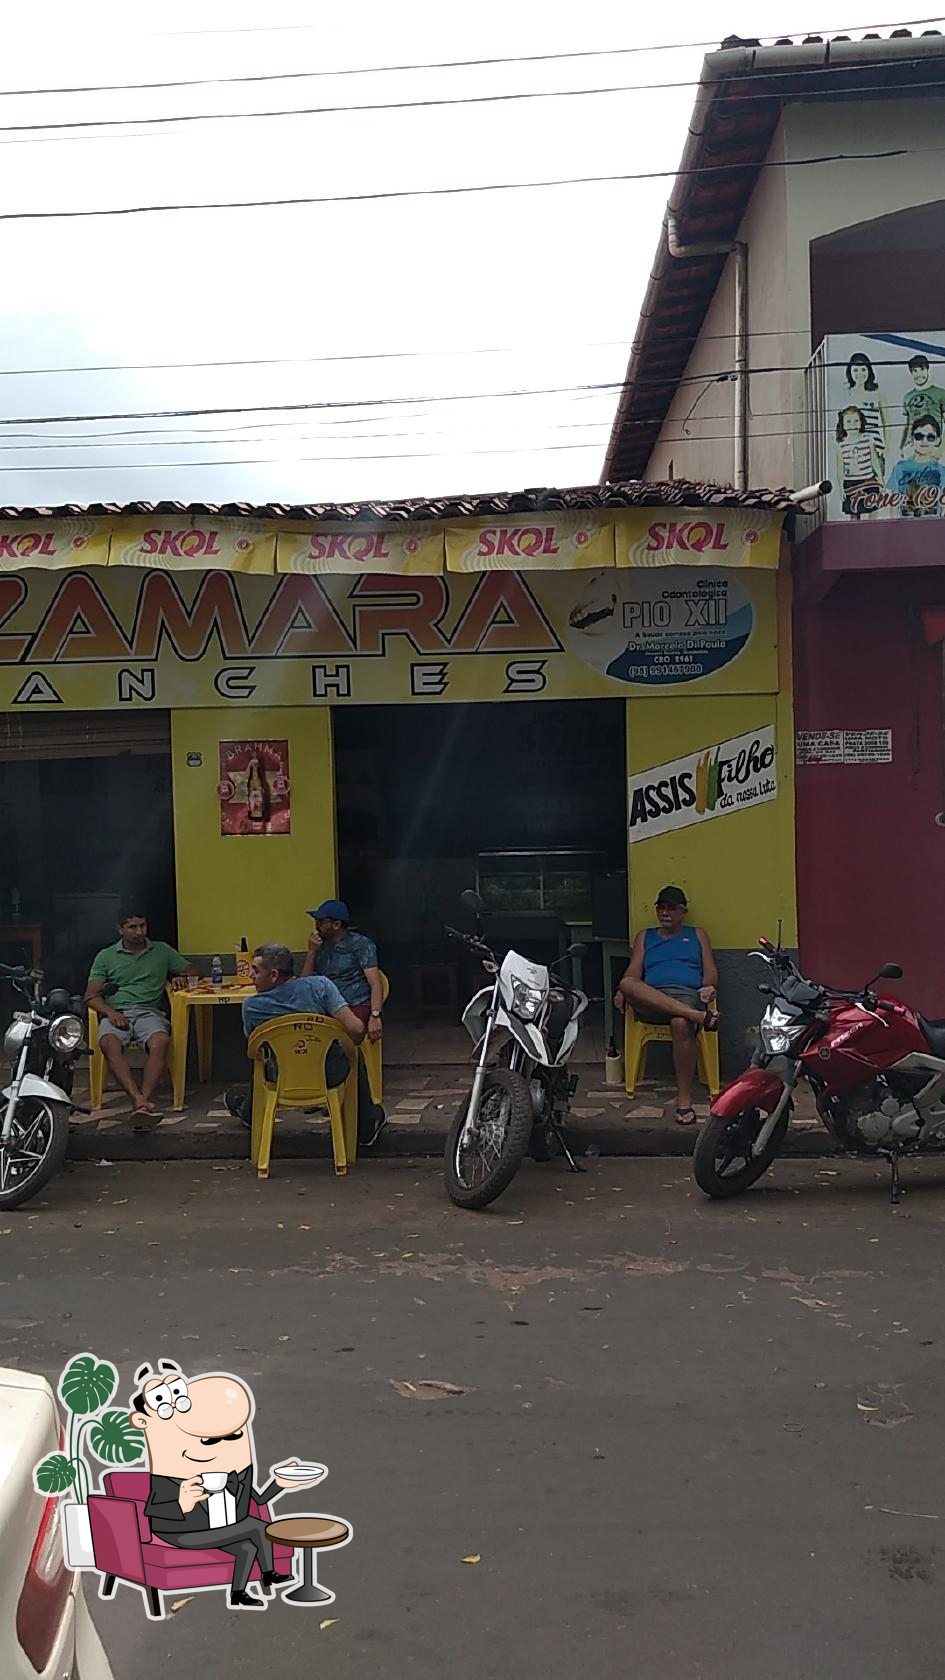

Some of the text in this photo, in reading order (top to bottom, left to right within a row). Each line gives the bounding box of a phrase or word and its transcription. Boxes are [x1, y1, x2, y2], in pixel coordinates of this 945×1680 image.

[138, 528, 220, 559] SKOL
[307, 531, 390, 562] SKOL
[477, 527, 560, 557] SKOL
[646, 521, 729, 552] SKOL
[623, 599, 728, 628] PIO XII
[645, 640, 684, 650] Marcelo
[225, 742, 282, 760] BRAHMA
[630, 739, 775, 827] ASSIS Filho
[720, 791, 735, 809] da
[736, 785, 758, 804] nossa
